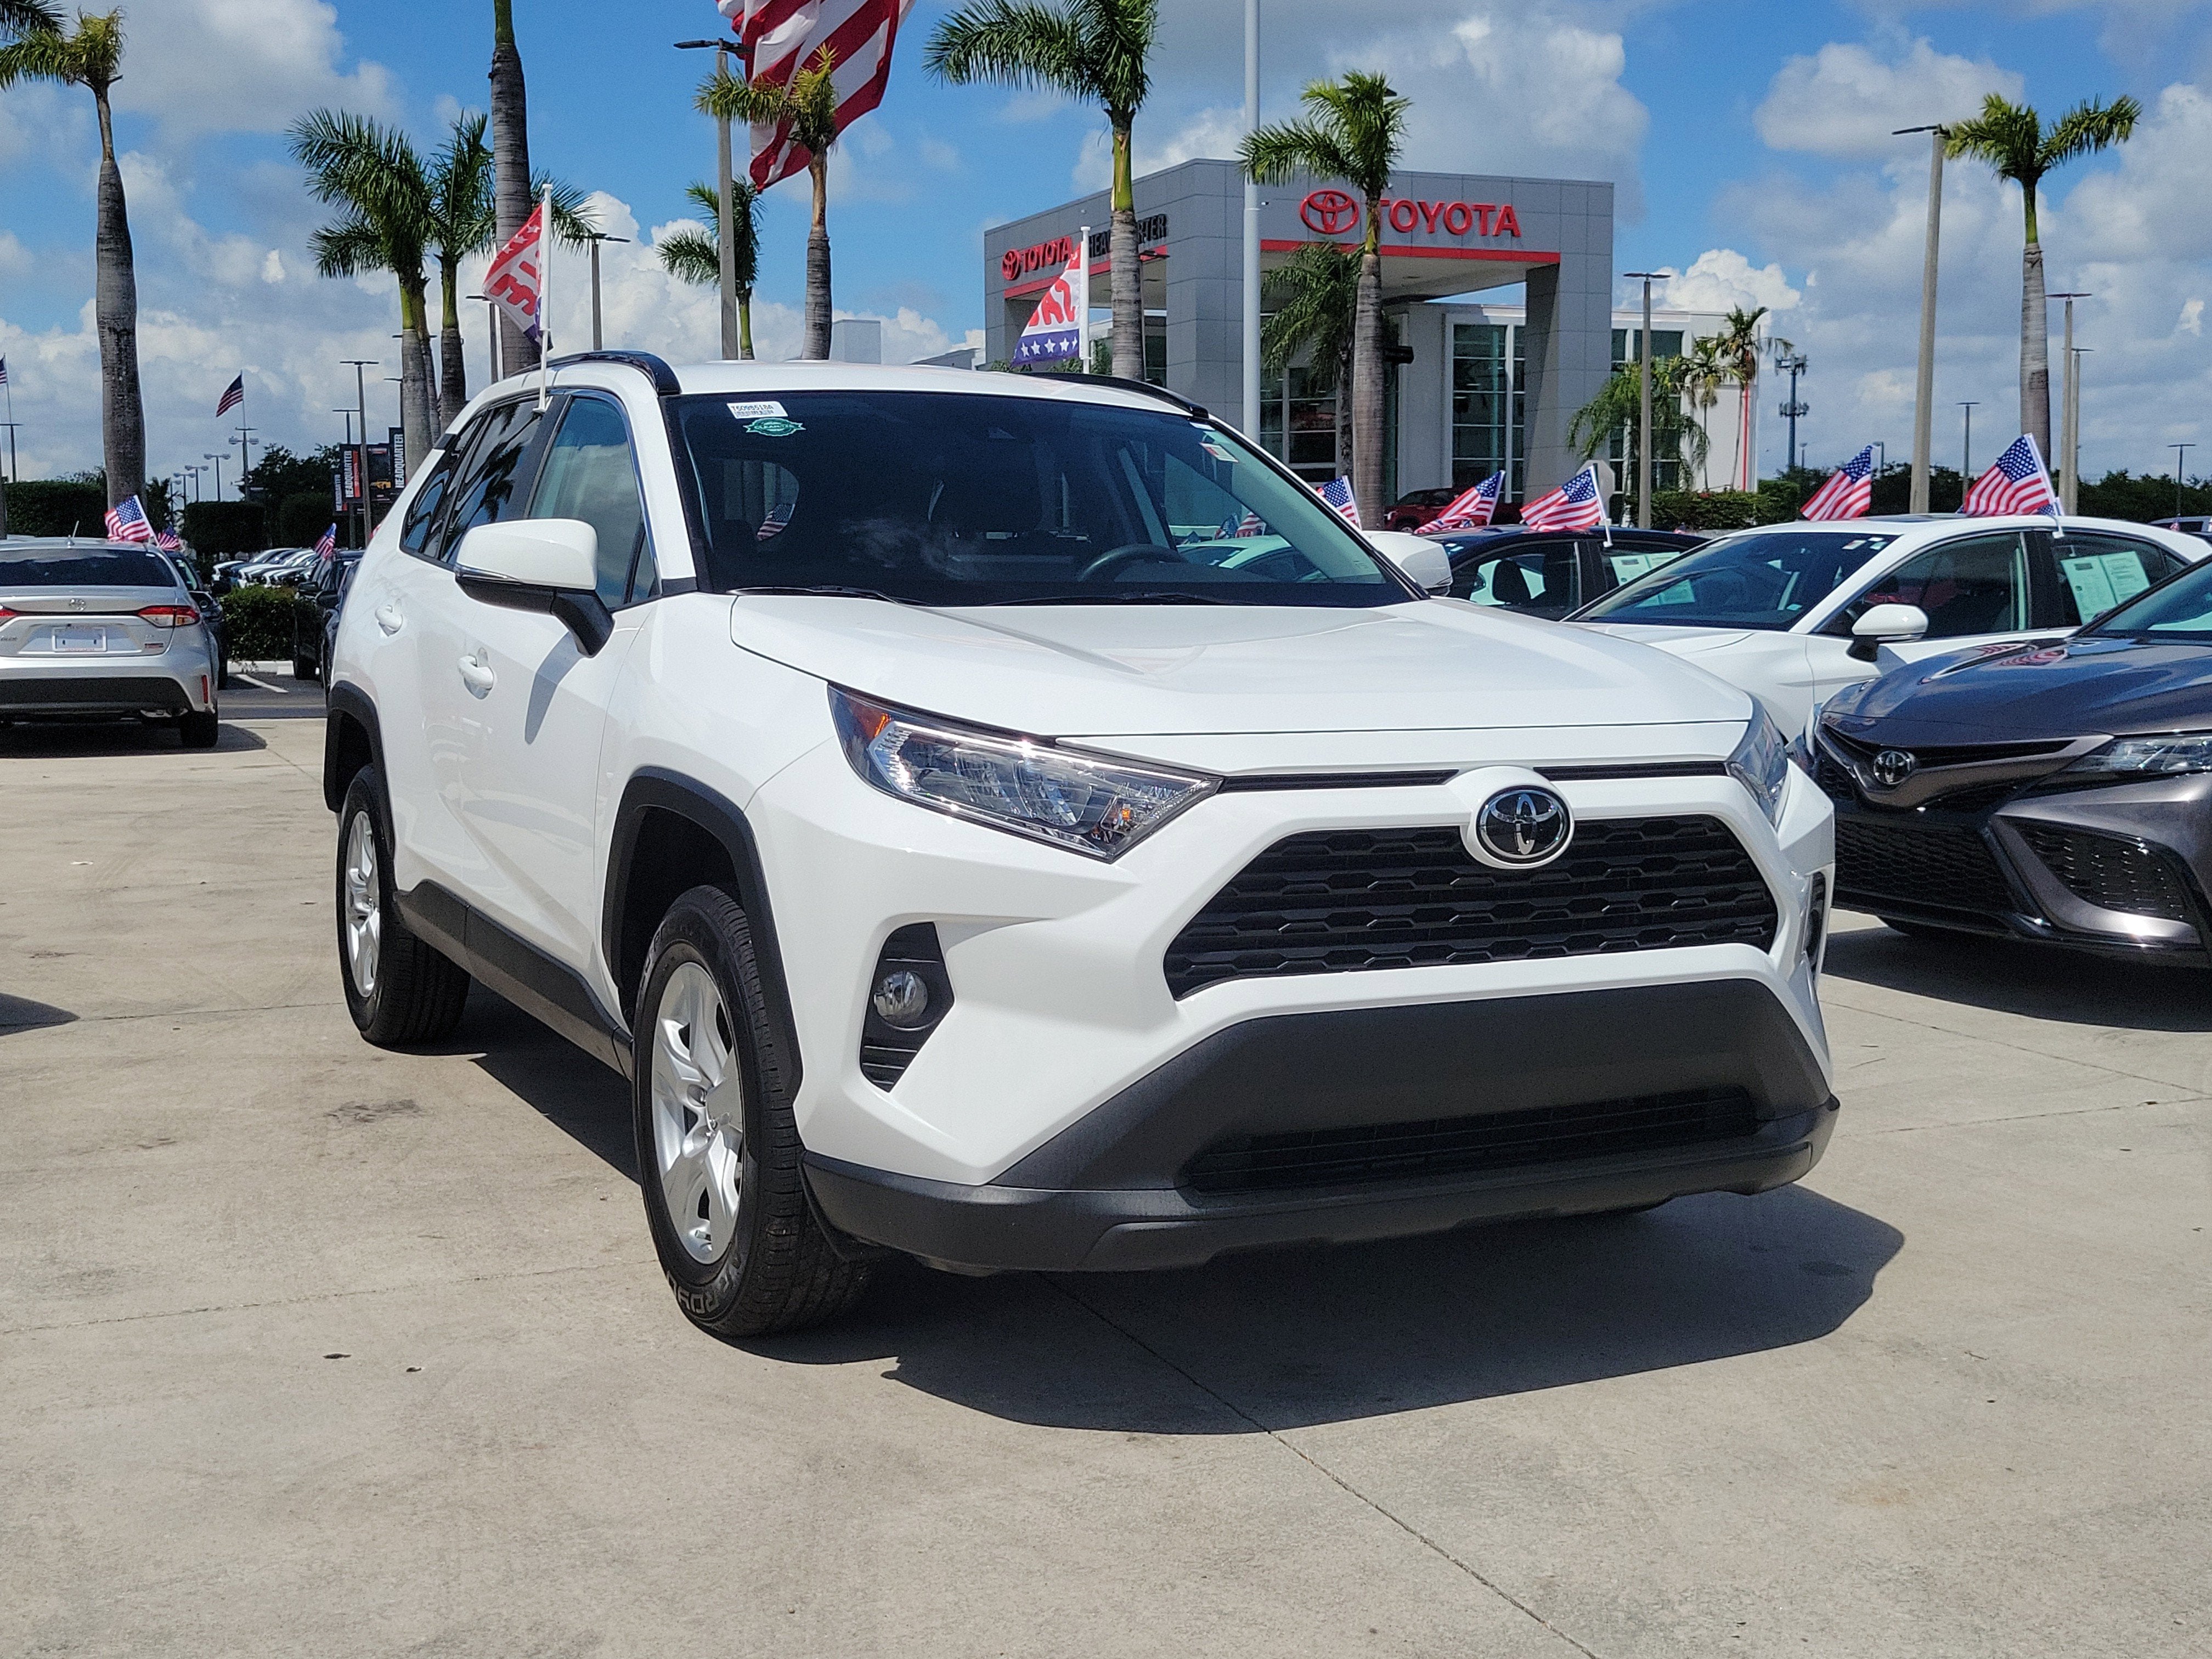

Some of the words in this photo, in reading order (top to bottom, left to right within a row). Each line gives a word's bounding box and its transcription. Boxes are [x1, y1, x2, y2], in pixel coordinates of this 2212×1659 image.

[1022, 235, 1073, 273] TOYOTA
[1088, 212, 1167, 259] HEARTER
[344, 450, 354, 498] HEADQUARTER
[393, 434, 405, 488] HEADQUARTER
